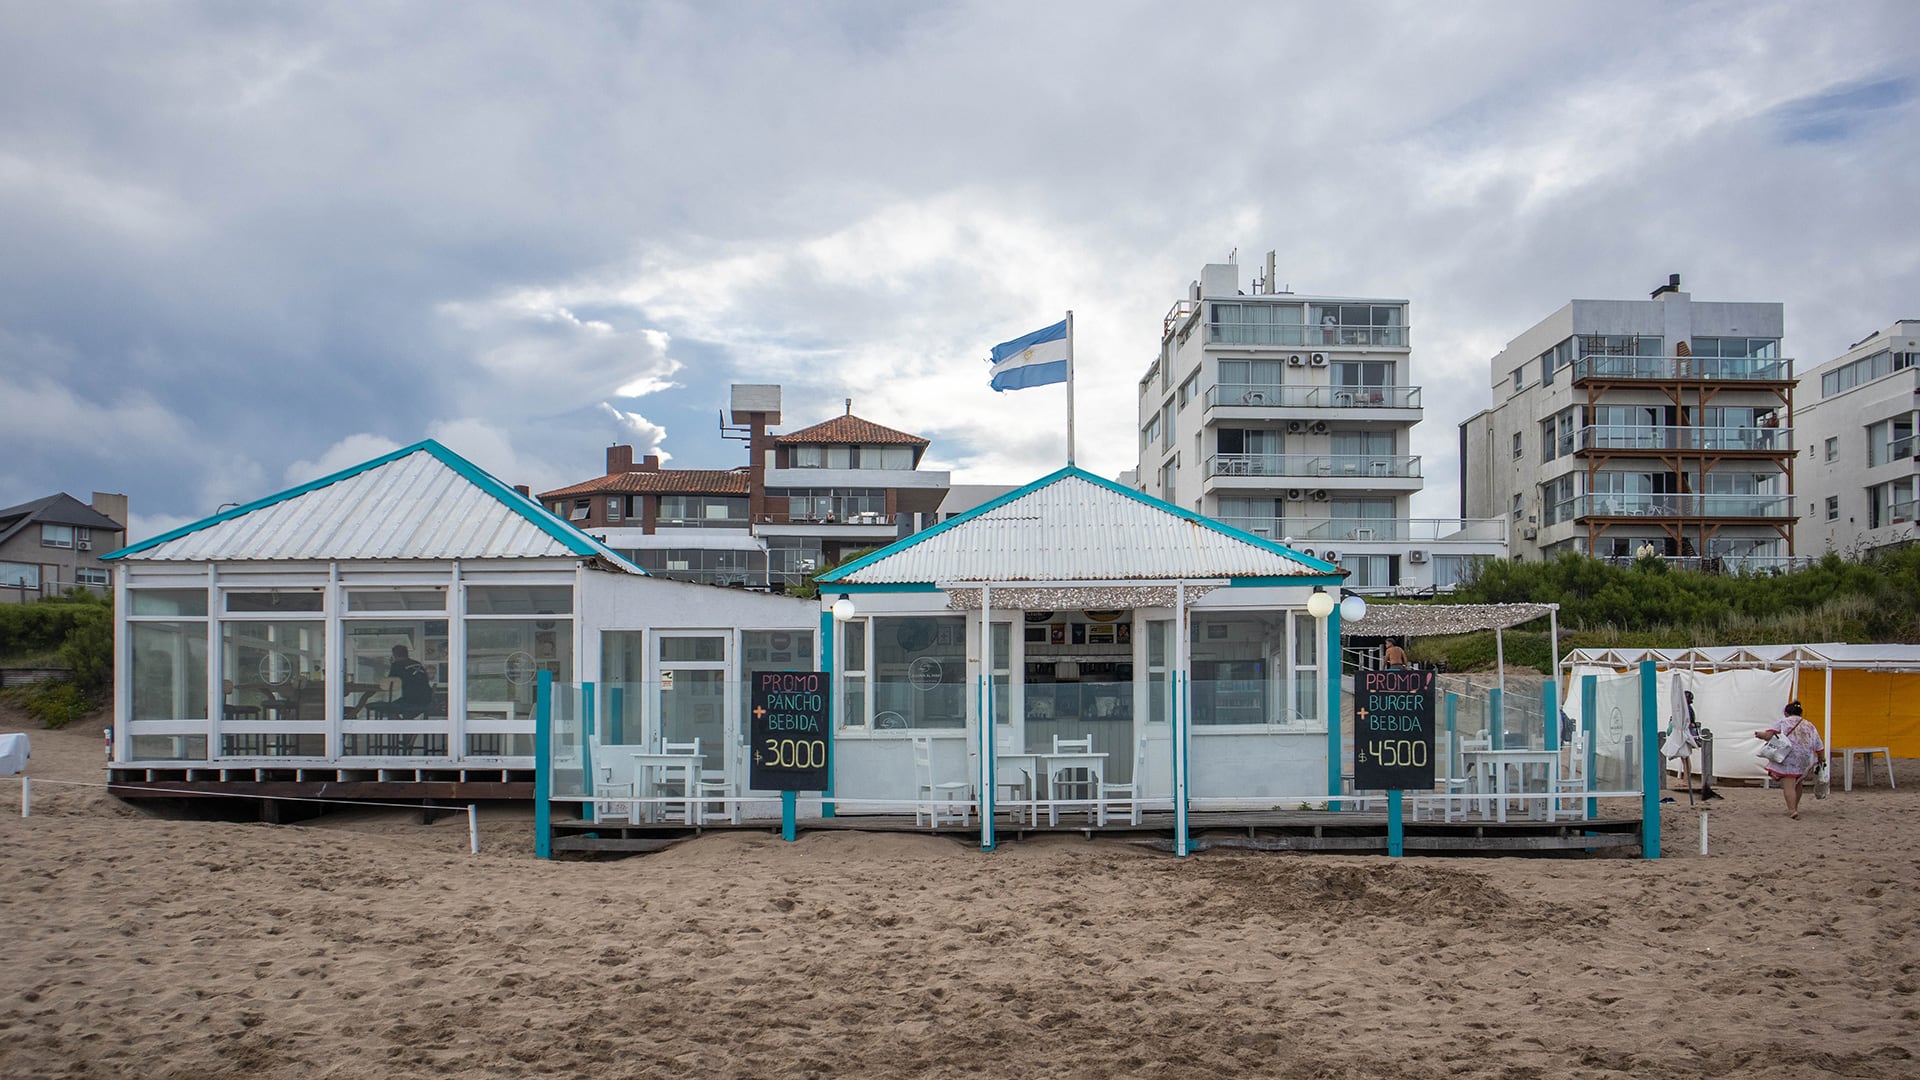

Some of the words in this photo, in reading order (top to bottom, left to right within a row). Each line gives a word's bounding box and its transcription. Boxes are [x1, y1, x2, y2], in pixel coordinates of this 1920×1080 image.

[762, 674, 818, 692] PROMO
[767, 694, 822, 712] PANCHO
[1369, 694, 1424, 712] BURGER
[768, 713, 819, 732] BEBIDA
[1369, 714, 1422, 732] BEBIDA
